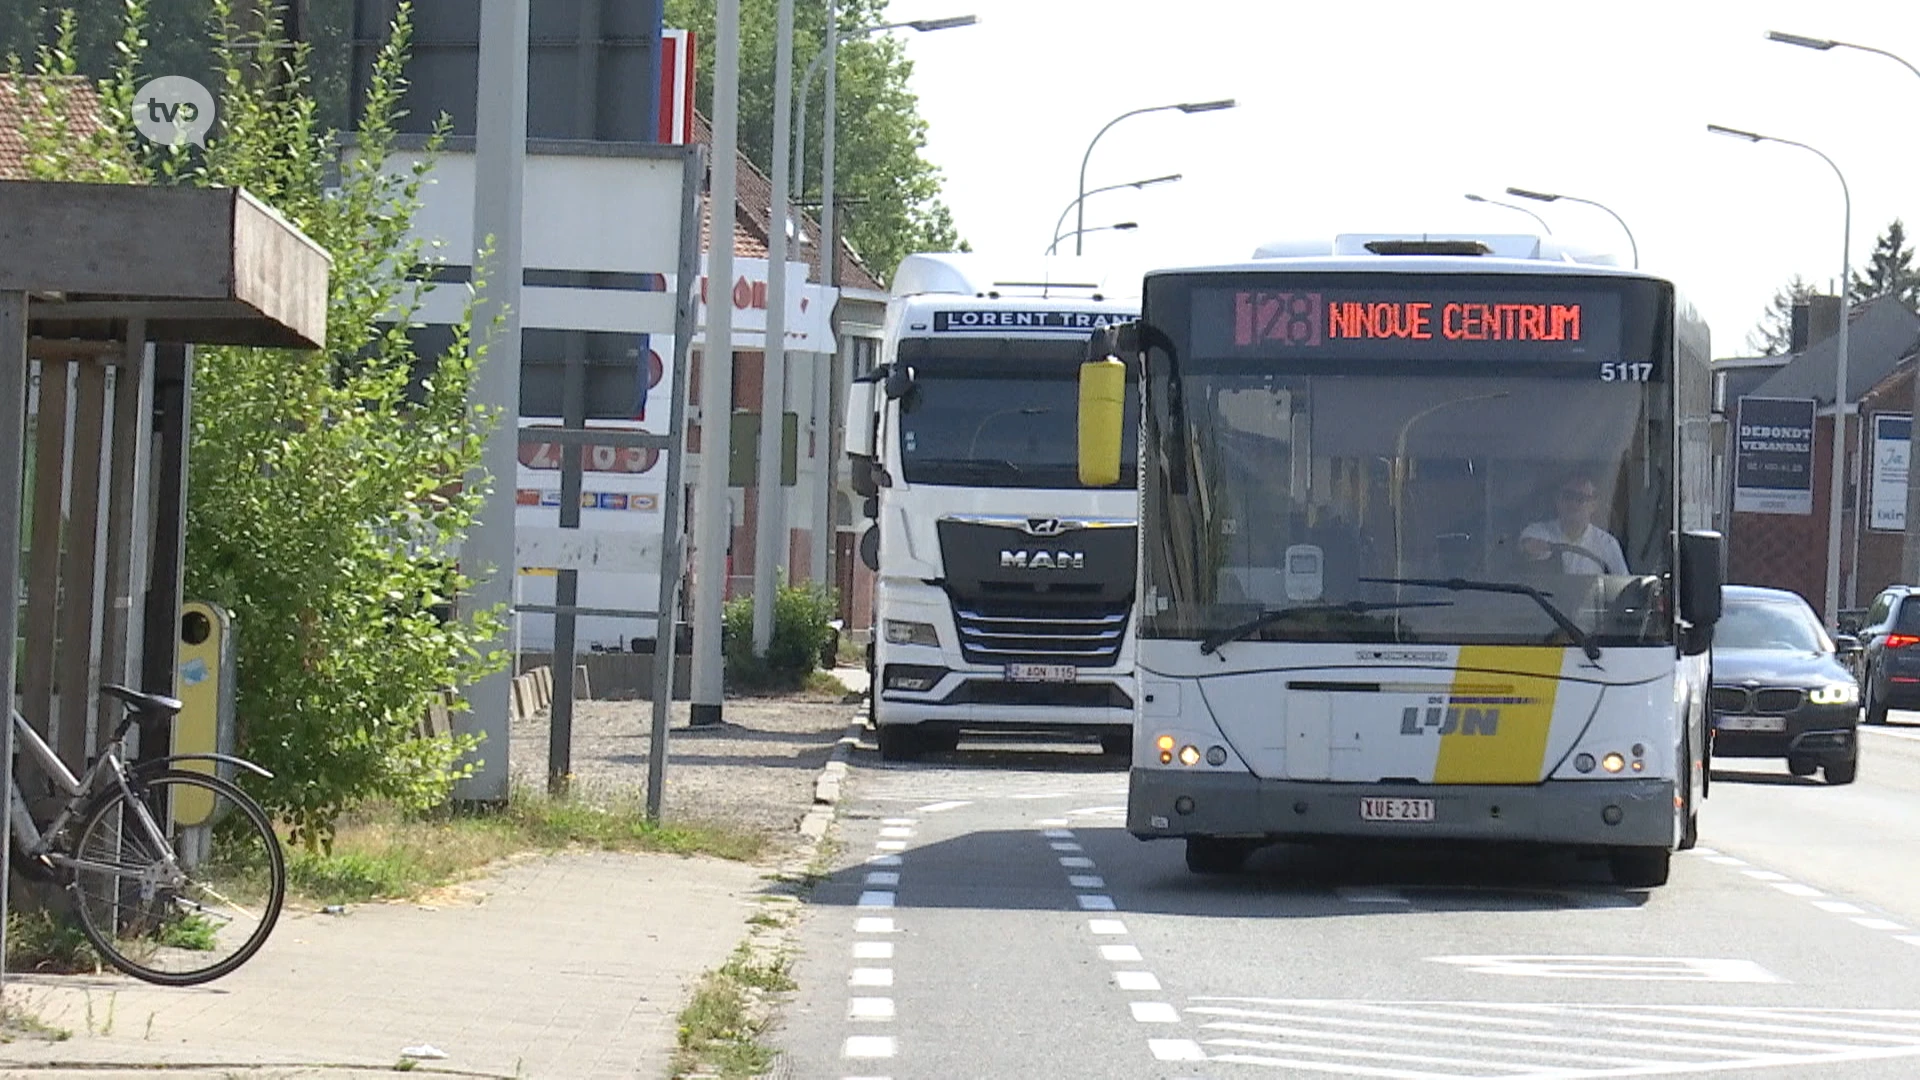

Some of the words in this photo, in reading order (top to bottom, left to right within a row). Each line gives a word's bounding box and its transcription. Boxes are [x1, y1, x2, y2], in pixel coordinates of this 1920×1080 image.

[947, 312, 1048, 326] LORENT
[1442, 303, 1581, 341] CENTRUM
[1601, 363, 1653, 381] 5117
[1001, 551, 1084, 568] MAN
[1400, 707, 1499, 736] LIJN
[1366, 801, 1429, 818] XUE-231
